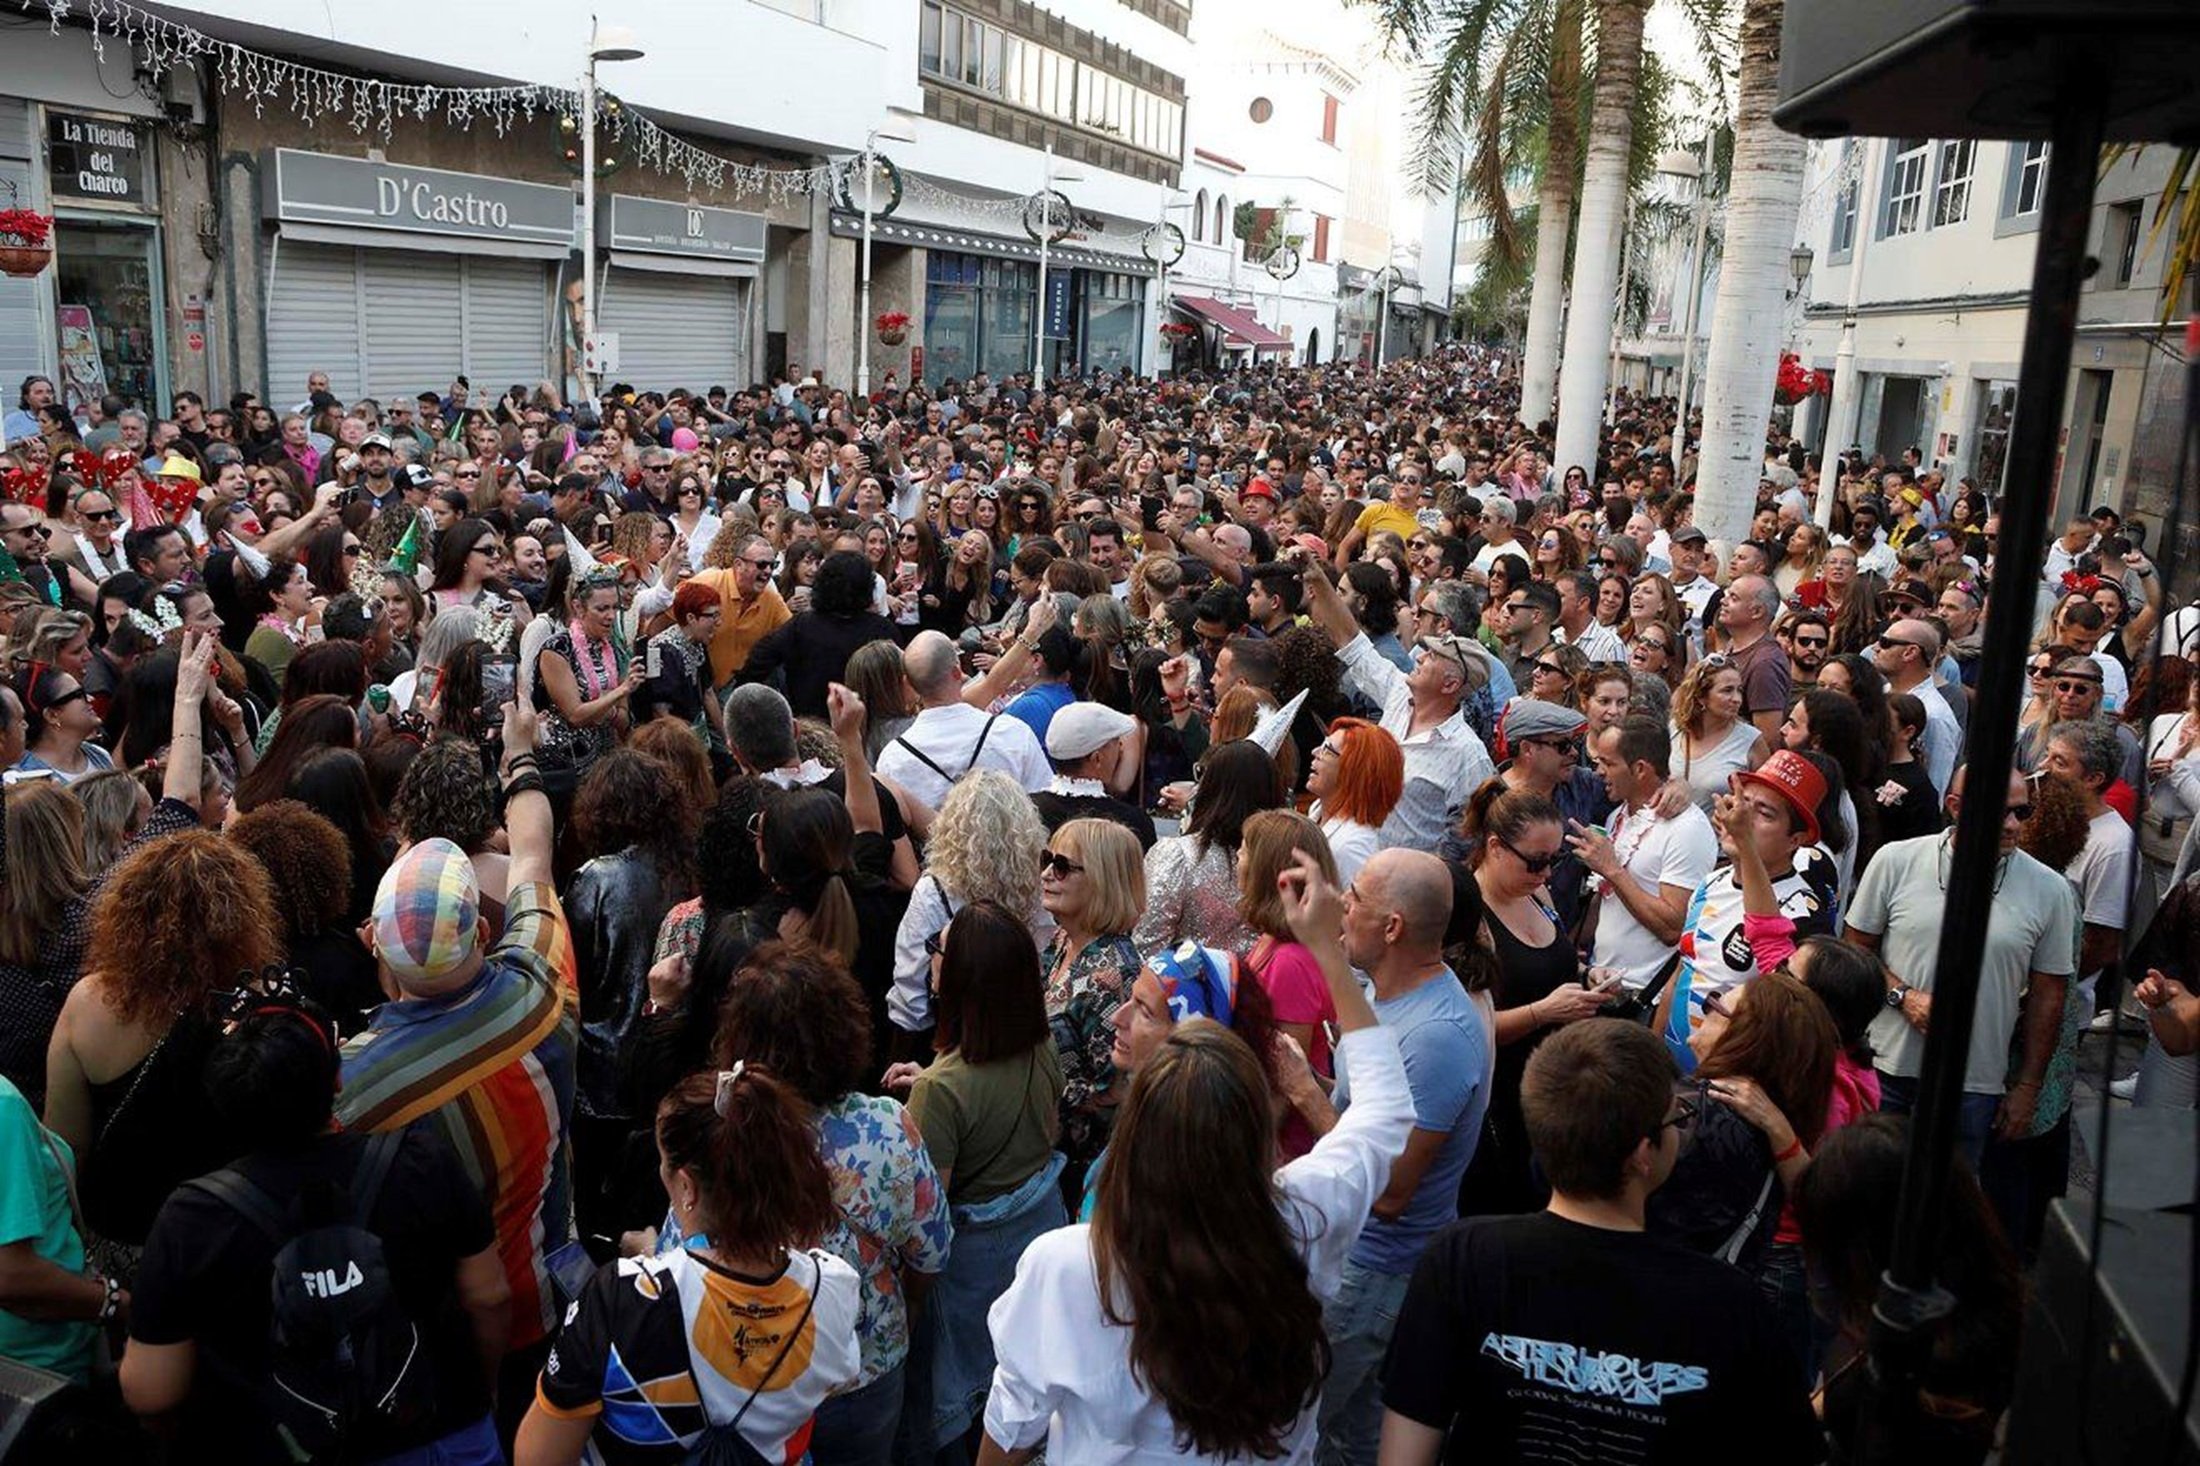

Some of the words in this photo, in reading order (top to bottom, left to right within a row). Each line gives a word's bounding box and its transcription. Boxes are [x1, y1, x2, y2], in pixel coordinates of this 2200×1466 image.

[63, 119, 82, 142] La
[85, 123, 136, 149] Tienda
[90, 151, 114, 173] del
[79, 170, 128, 194] Charco
[377, 176, 508, 228] D'Castro
[687, 208, 705, 237] DC
[301, 1260, 364, 1298] FILA
